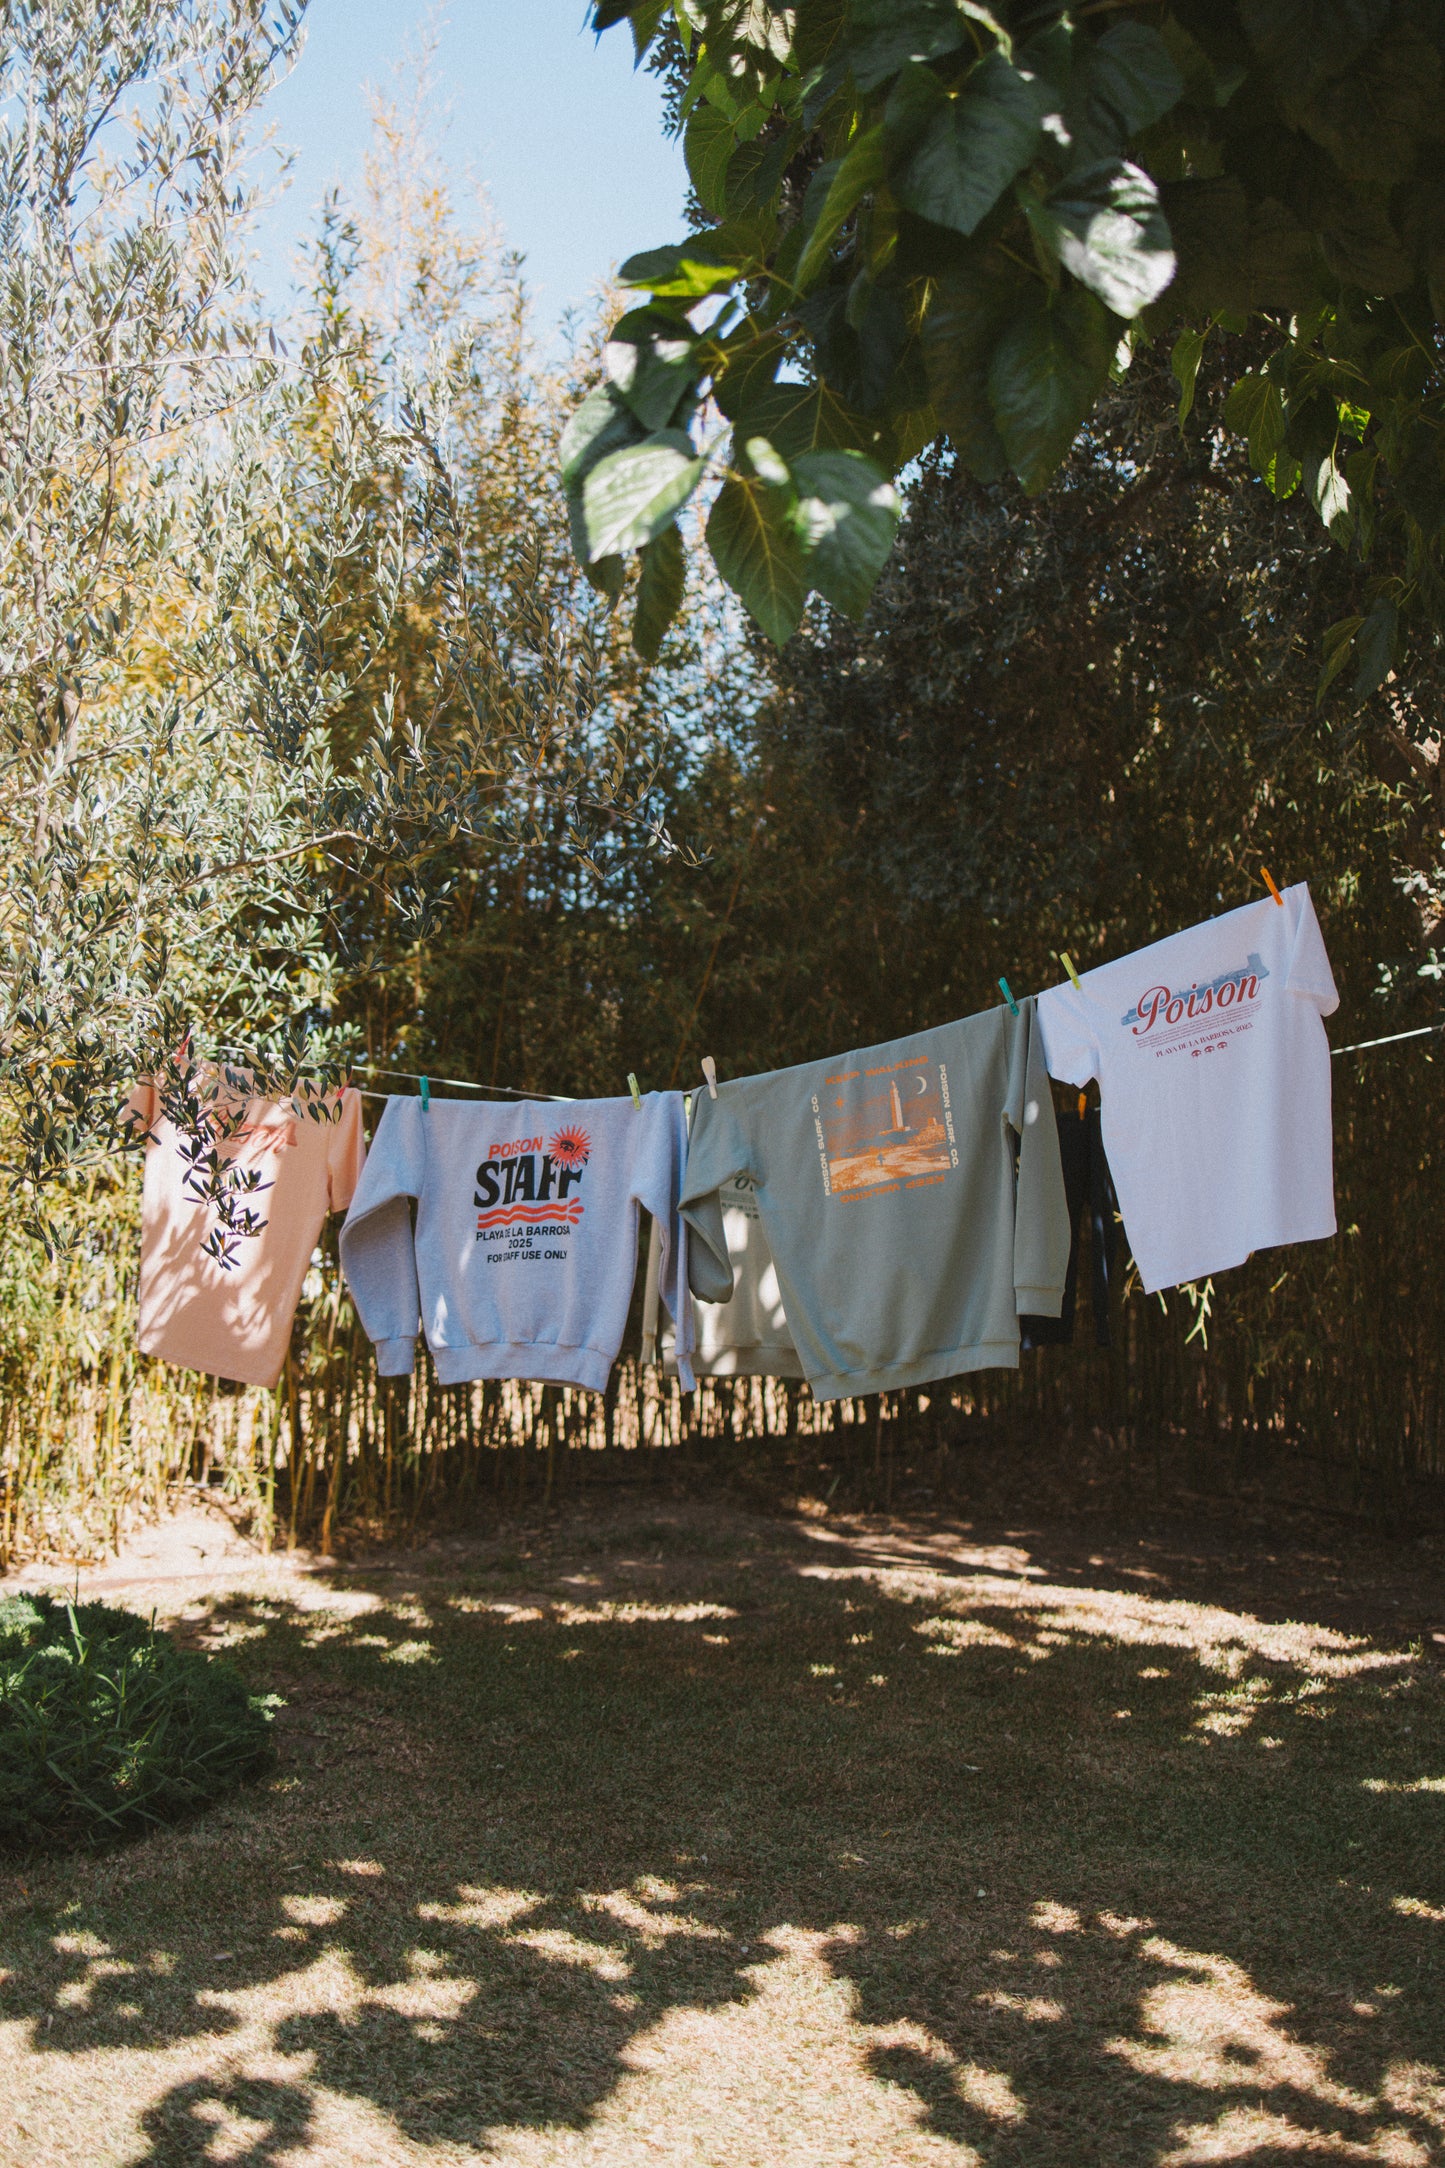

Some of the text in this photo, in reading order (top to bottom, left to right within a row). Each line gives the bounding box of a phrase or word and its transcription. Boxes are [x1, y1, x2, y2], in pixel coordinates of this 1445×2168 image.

[1132, 976, 1261, 1035] Poison
[939, 1063, 951, 1108] POISON
[488, 1136, 543, 1160] POISON
[473, 1151, 589, 1208] STAFF
[819, 1153, 831, 1196] POISON
[476, 1230, 504, 1242] PLAYA
[511, 1226, 524, 1237] LA
[525, 1225, 571, 1237] BARROSA
[508, 1237, 533, 1249] 2025
[487, 1253, 503, 1264] FOR
[521, 1250, 541, 1260] USE
[544, 1250, 568, 1260] ONLY
